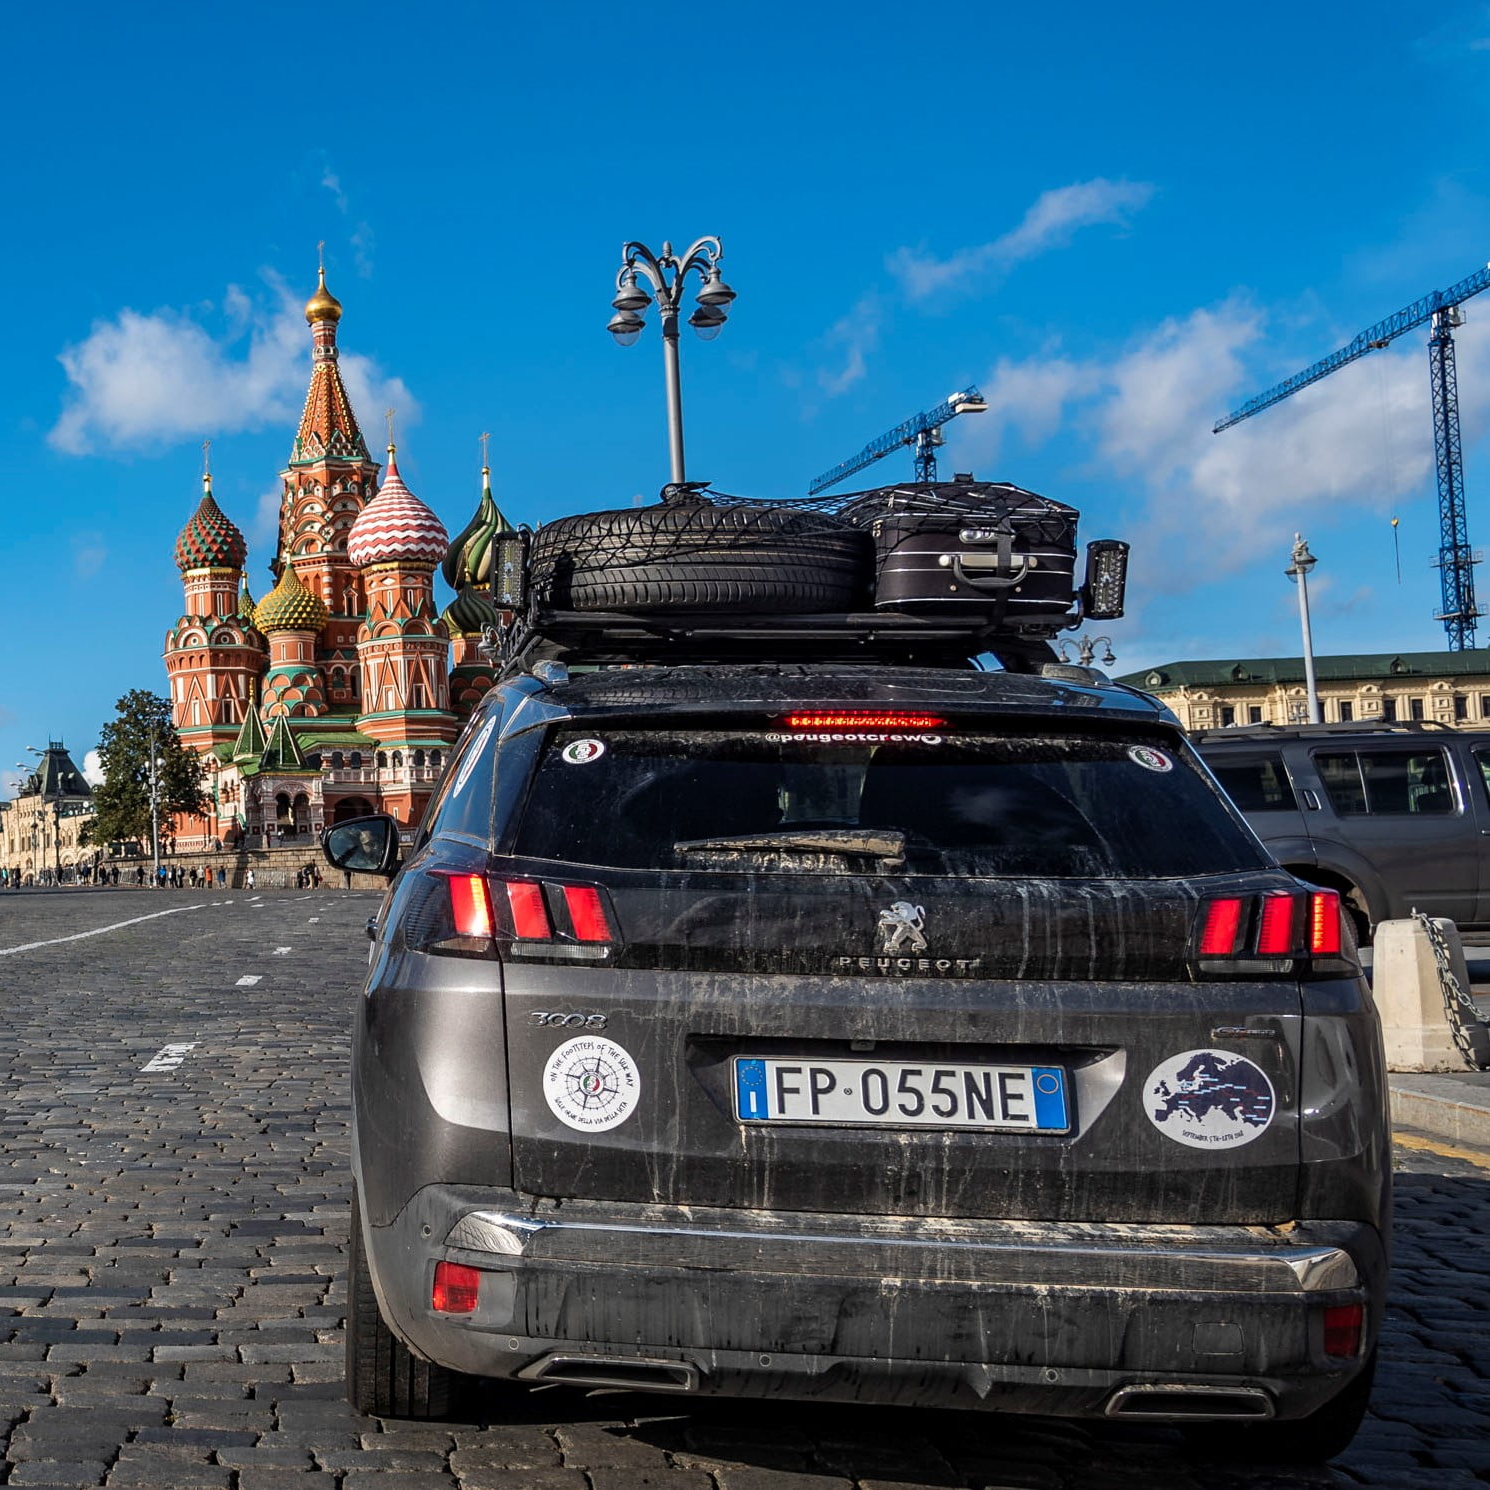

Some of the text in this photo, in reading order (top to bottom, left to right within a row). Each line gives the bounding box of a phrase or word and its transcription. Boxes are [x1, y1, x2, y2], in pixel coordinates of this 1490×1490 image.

[839, 955, 971, 972] PEUGEOT
[529, 1011, 607, 1029] 3008
[553, 1057, 563, 1069] THE
[561, 1041, 595, 1060] FOOTSTEPS
[607, 1046, 620, 1060] THE
[625, 1072, 634, 1087] WAY
[774, 1066, 1030, 1122] FP 055NE
[593, 1117, 604, 1125] VIA
